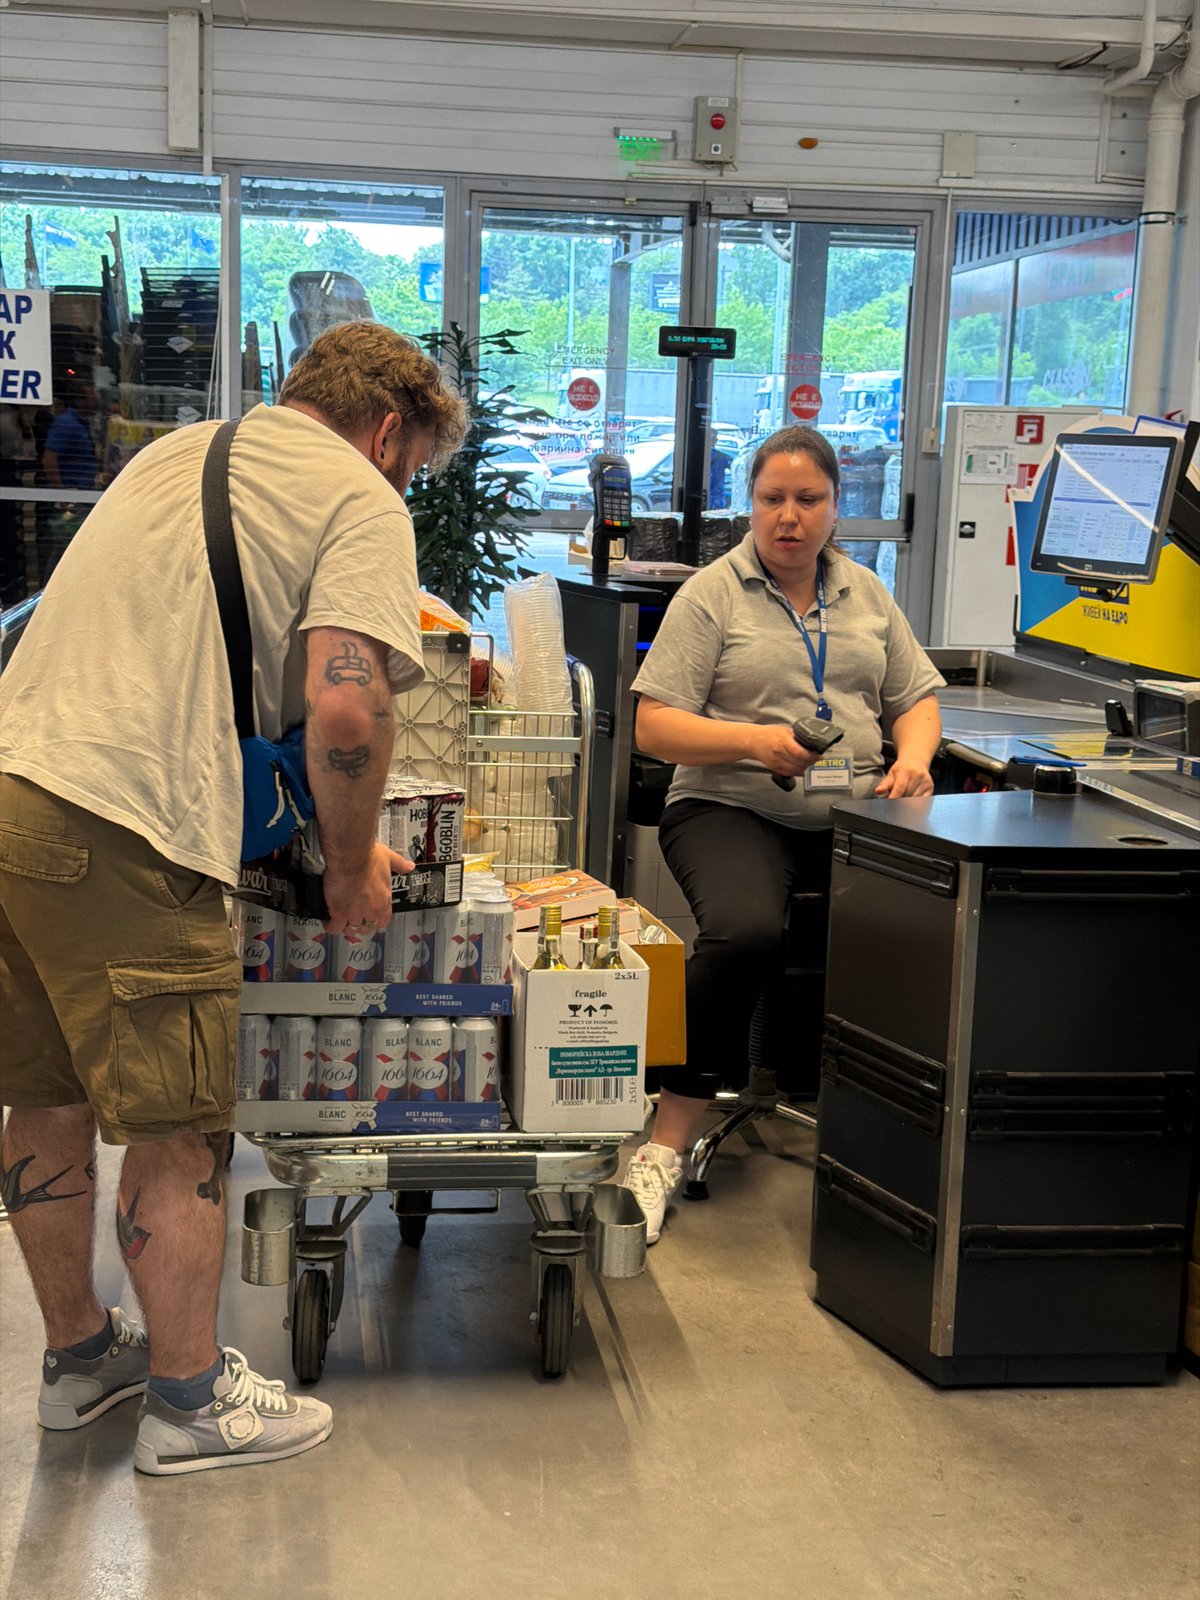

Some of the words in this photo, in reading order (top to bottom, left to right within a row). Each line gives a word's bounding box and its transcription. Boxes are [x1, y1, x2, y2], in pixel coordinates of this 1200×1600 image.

[557, 345, 615, 355] EMERGENCY
[562, 357, 582, 365] EXIT
[584, 357, 610, 366] ONLY
[0, 369, 42, 400] ER
[573, 385, 586, 393] НЕ
[588, 385, 595, 393] Е
[568, 393, 599, 403] ИЗХОД
[795, 392, 808, 401] НЕ
[580, 433, 616, 443] пожар
[244, 944, 265, 960] 64
[288, 945, 321, 961] 1664
[614, 972, 640, 980] 2x5L
[328, 993, 357, 1001] BLANC
[575, 989, 608, 999] fragile
[324, 1038, 352, 1047] BLANC
[415, 1037, 442, 1047] BLANC
[321, 1067, 354, 1081] 1664
[411, 1067, 444, 1081] 1664
[318, 1110, 347, 1118] BLANC
[354, 1110, 375, 1118] 1664
